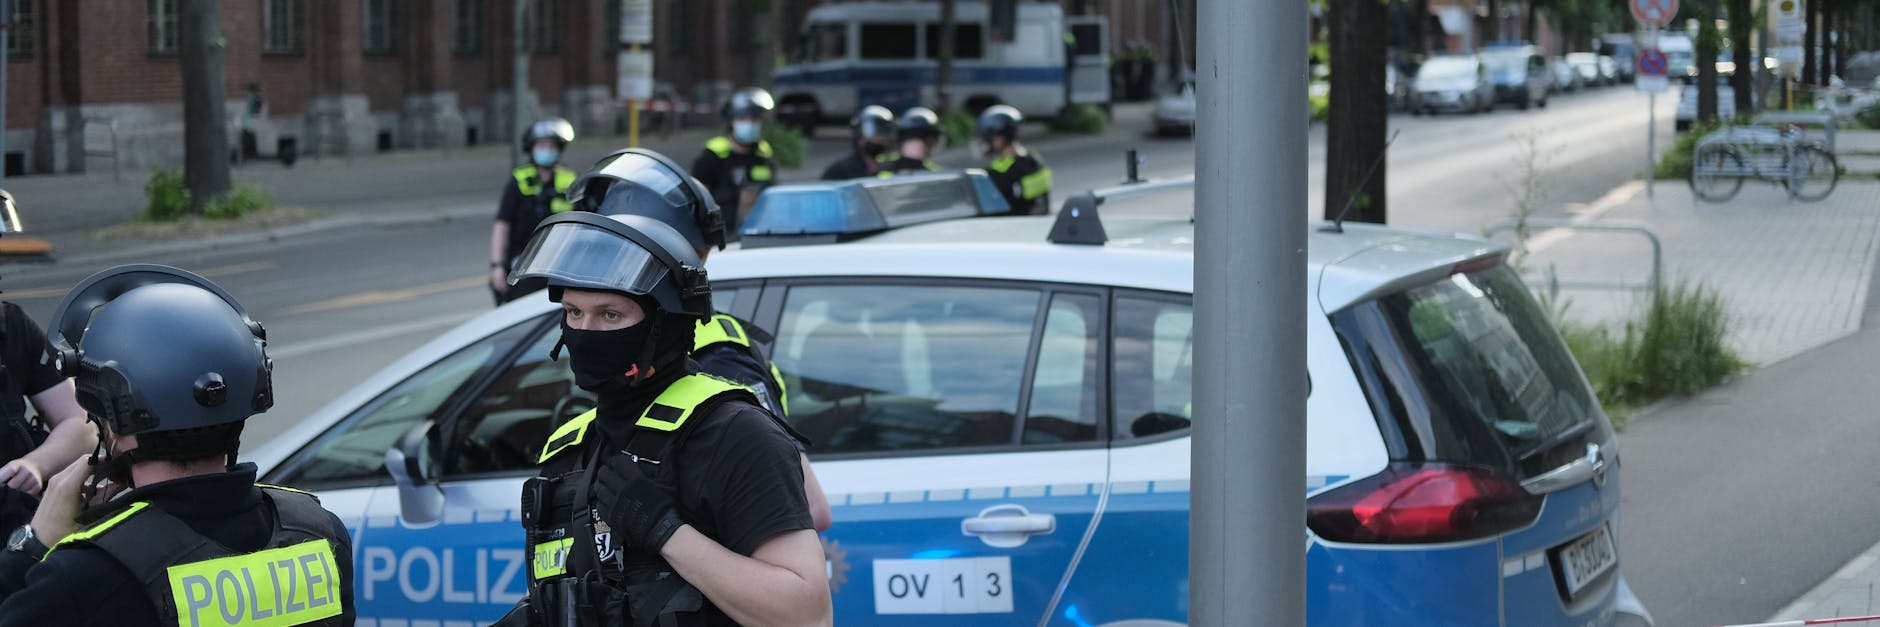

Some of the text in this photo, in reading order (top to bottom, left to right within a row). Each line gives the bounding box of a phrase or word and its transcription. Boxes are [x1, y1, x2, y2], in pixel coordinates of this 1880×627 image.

[181, 551, 334, 627] POLIZEI
[888, 572, 1001, 599] OV 1 3
